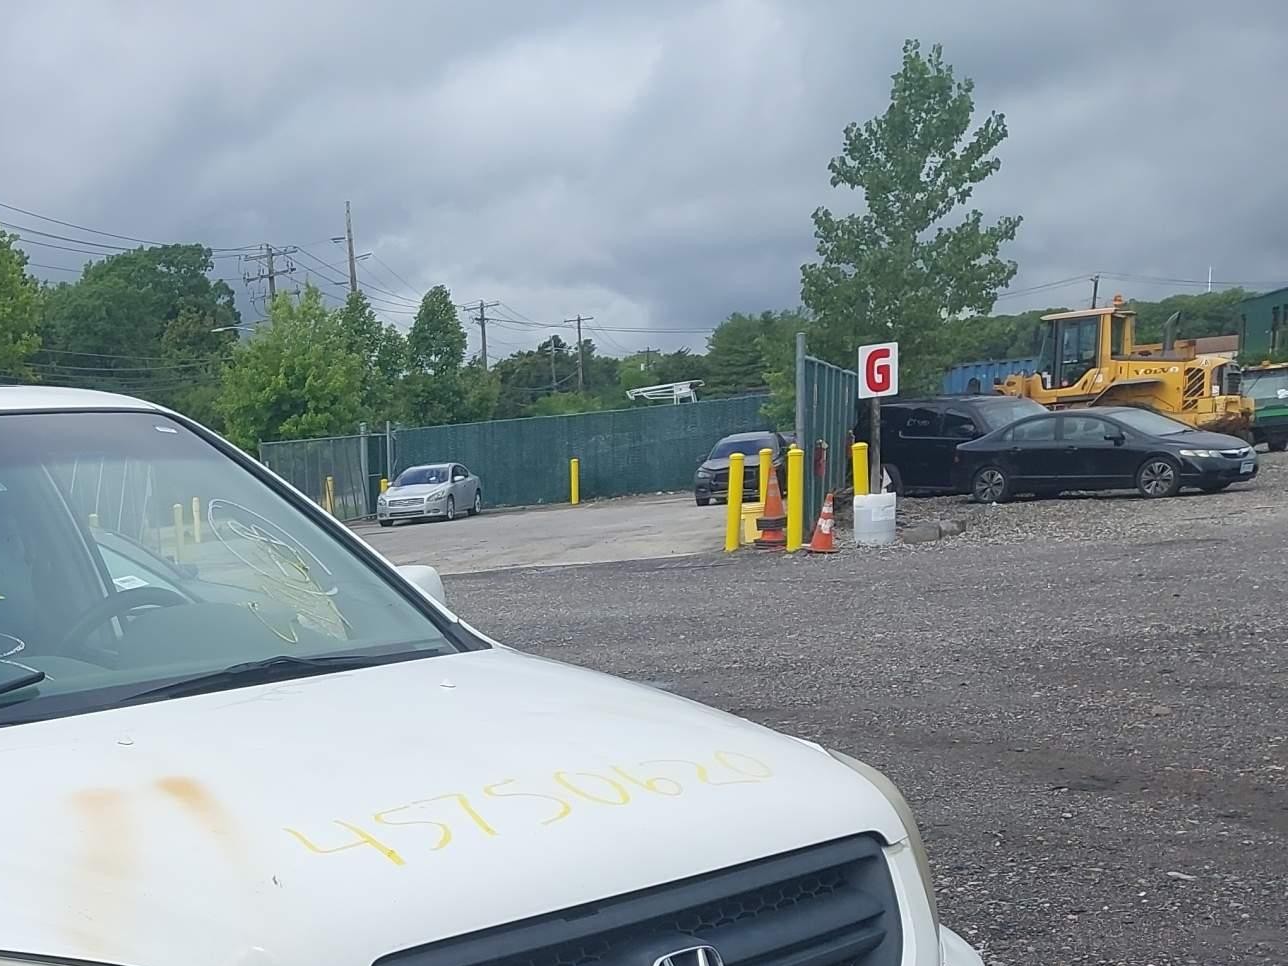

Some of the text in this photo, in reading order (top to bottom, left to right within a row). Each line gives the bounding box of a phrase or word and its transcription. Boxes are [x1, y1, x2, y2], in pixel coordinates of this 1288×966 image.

[865, 348, 891, 393] G
[1134, 366, 1180, 376] VOLVO
[282, 750, 774, 866] 45750620
